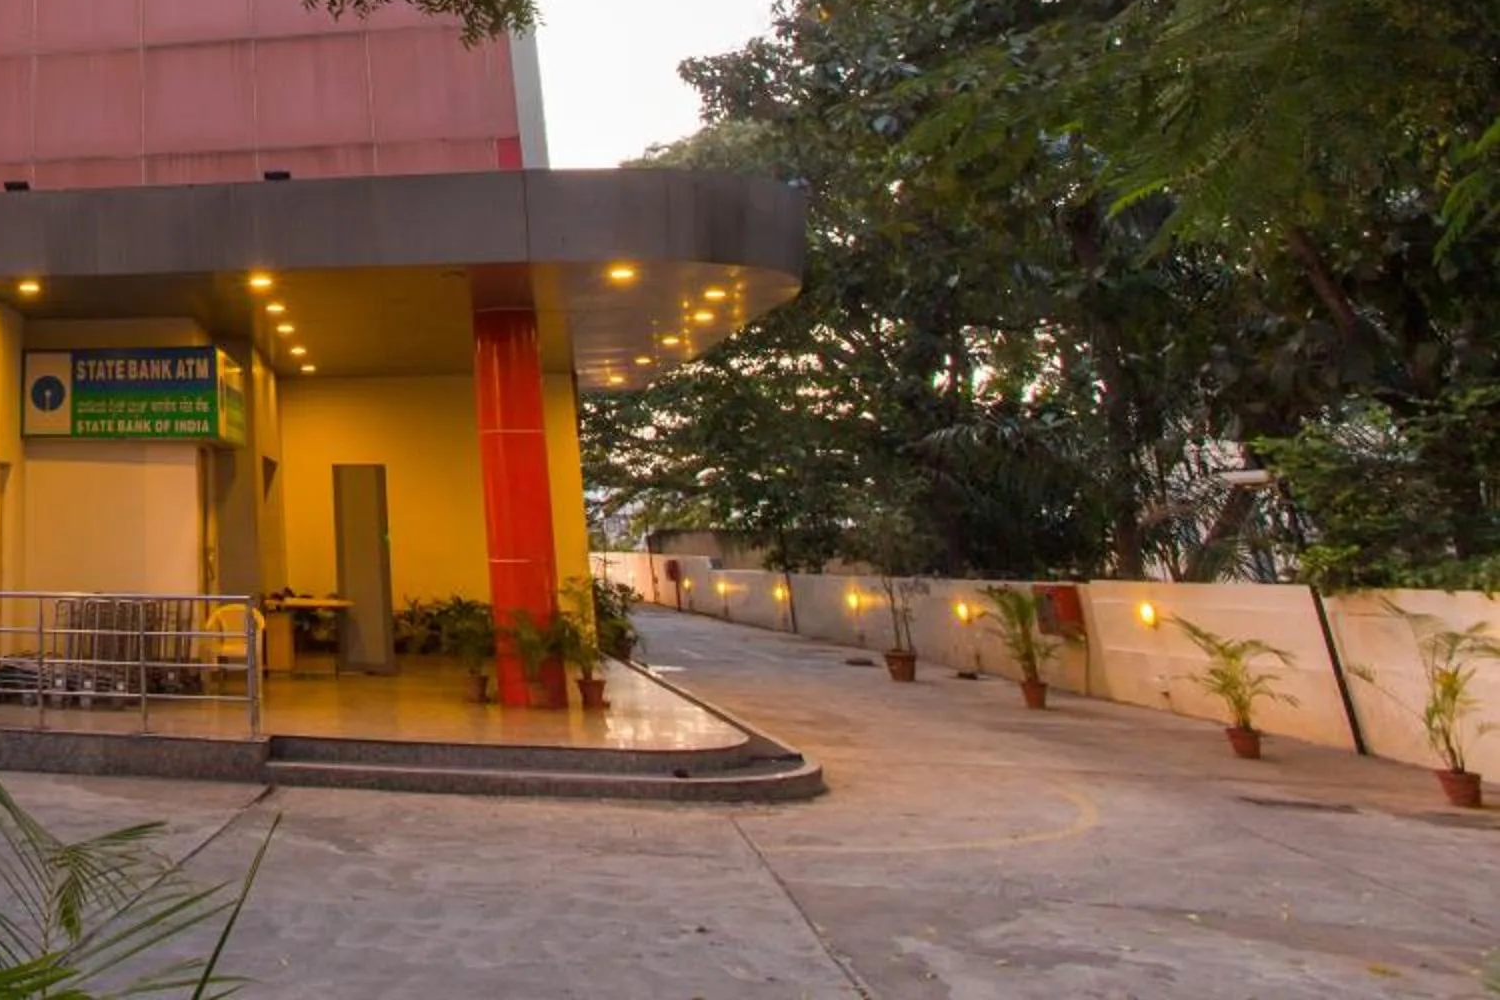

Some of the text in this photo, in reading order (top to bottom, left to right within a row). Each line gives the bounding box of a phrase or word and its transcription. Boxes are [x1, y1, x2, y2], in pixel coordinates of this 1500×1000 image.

[76, 358, 210, 380] STATE BANK ATM
[77, 419, 210, 433] STATE BANK OF INDIA
